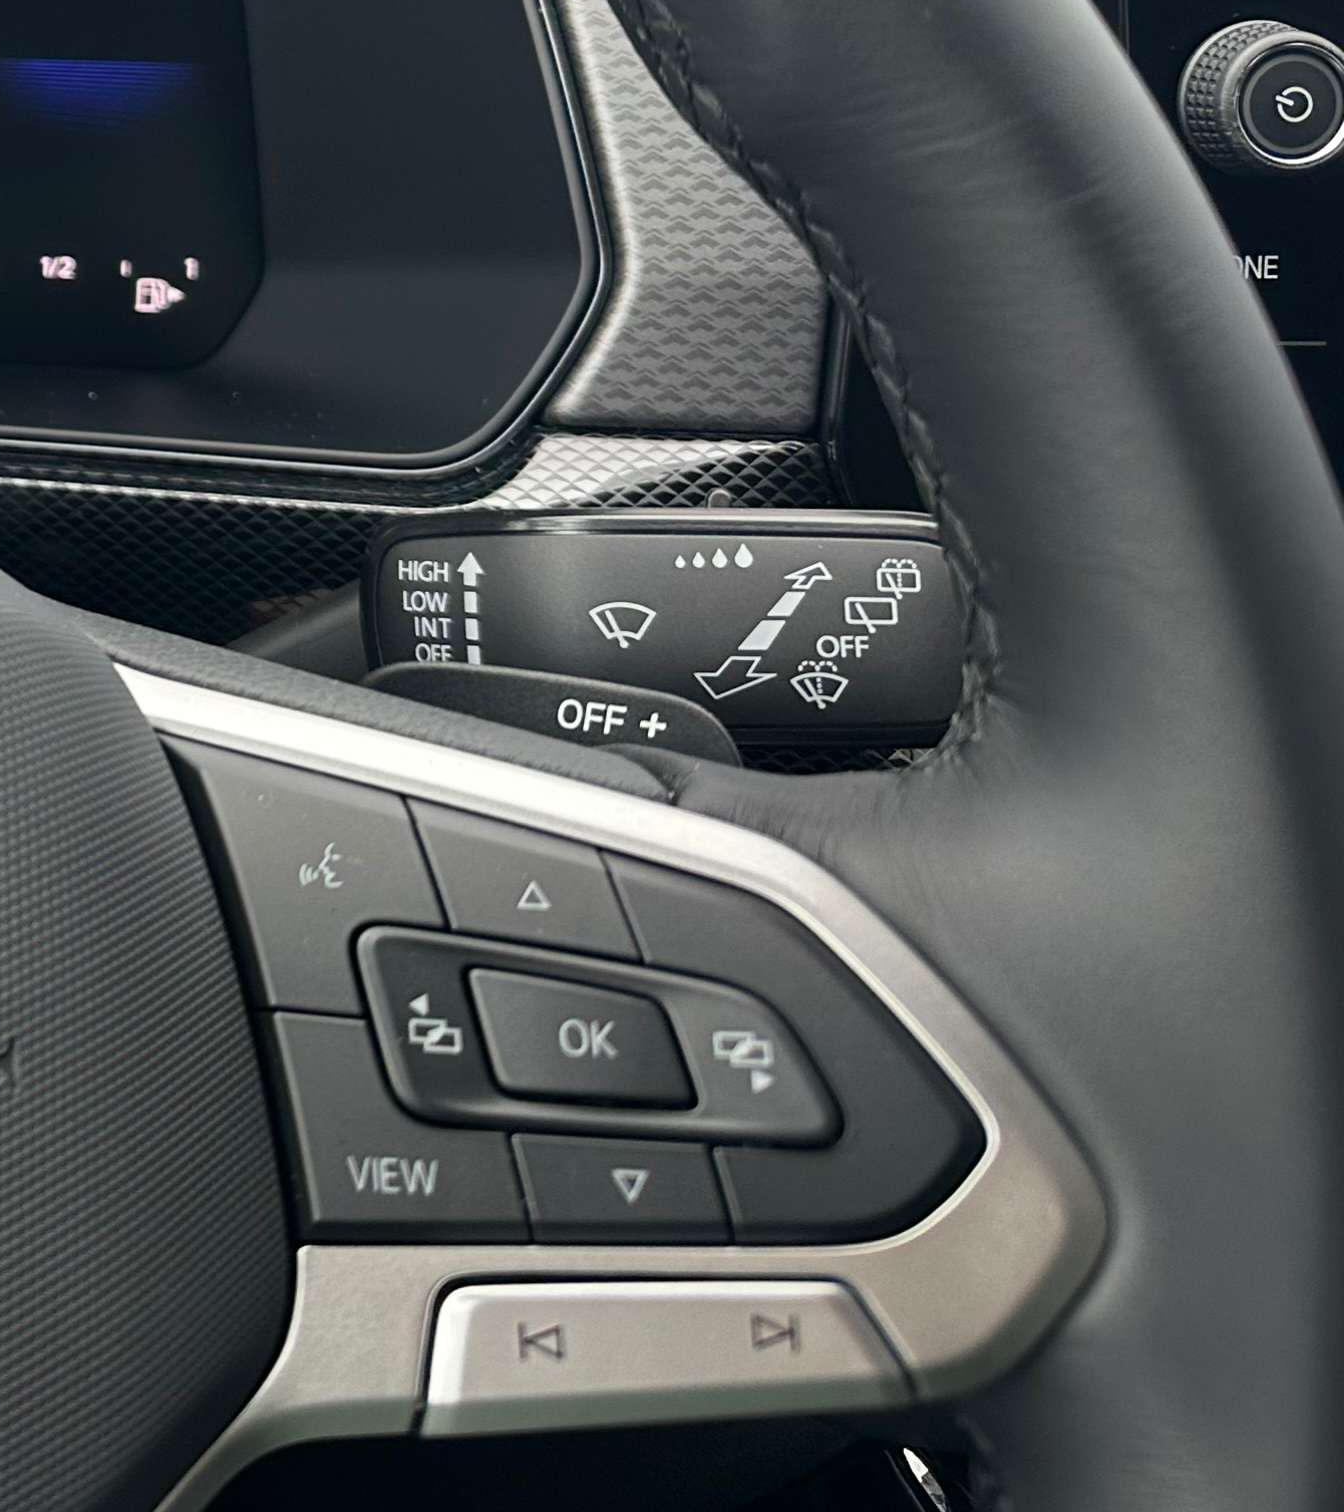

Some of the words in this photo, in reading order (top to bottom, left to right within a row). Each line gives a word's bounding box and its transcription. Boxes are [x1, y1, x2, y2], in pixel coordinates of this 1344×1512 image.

[39, 255, 78, 281] 1/2
[397, 558, 450, 583] HIGH
[402, 590, 449, 614] LOW
[414, 616, 452, 640] INT
[414, 642, 453, 663] OFF
[816, 635, 870, 659] OFF
[556, 698, 629, 736] OFF
[558, 1019, 618, 1059] OK
[347, 1155, 439, 1197] VIEW
